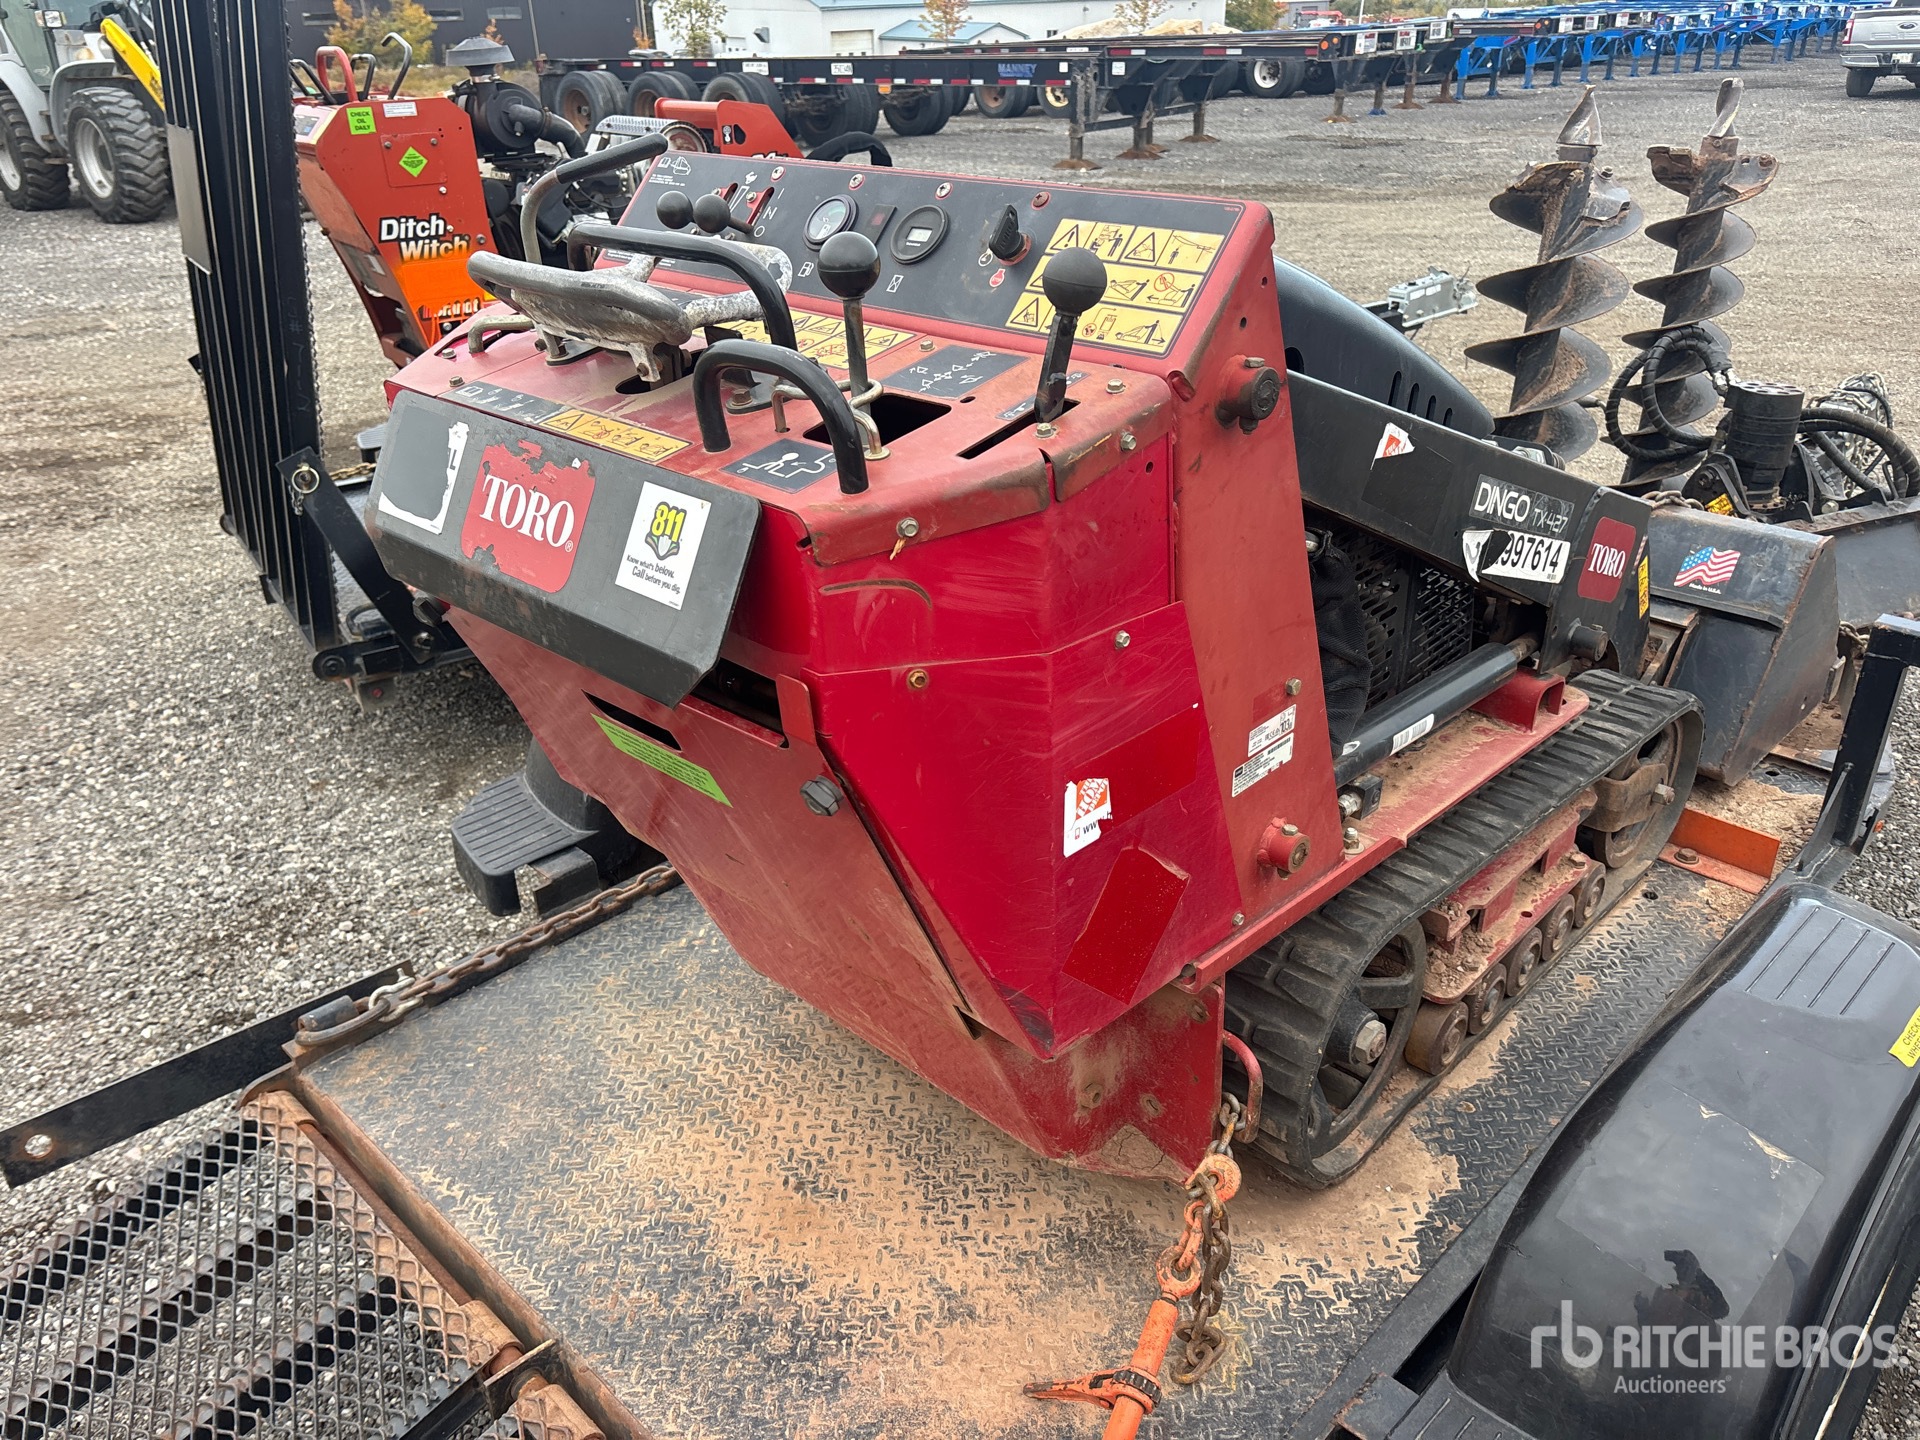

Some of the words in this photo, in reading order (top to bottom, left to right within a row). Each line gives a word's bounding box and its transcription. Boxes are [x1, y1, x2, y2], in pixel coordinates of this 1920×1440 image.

[380, 214, 446, 242] Ditch
[400, 235, 468, 262] Witch
[479, 474, 575, 548] TORO
[1474, 481, 1531, 523] DINGO
[651, 503, 686, 544] 811
[626, 554, 640, 565] Know
[1588, 543, 1626, 580] TORO
[631, 565, 647, 580] Call
[644, 572, 662, 586] before
[660, 580, 672, 590] you
[1902, 1021, 1920, 1047] CHECK
